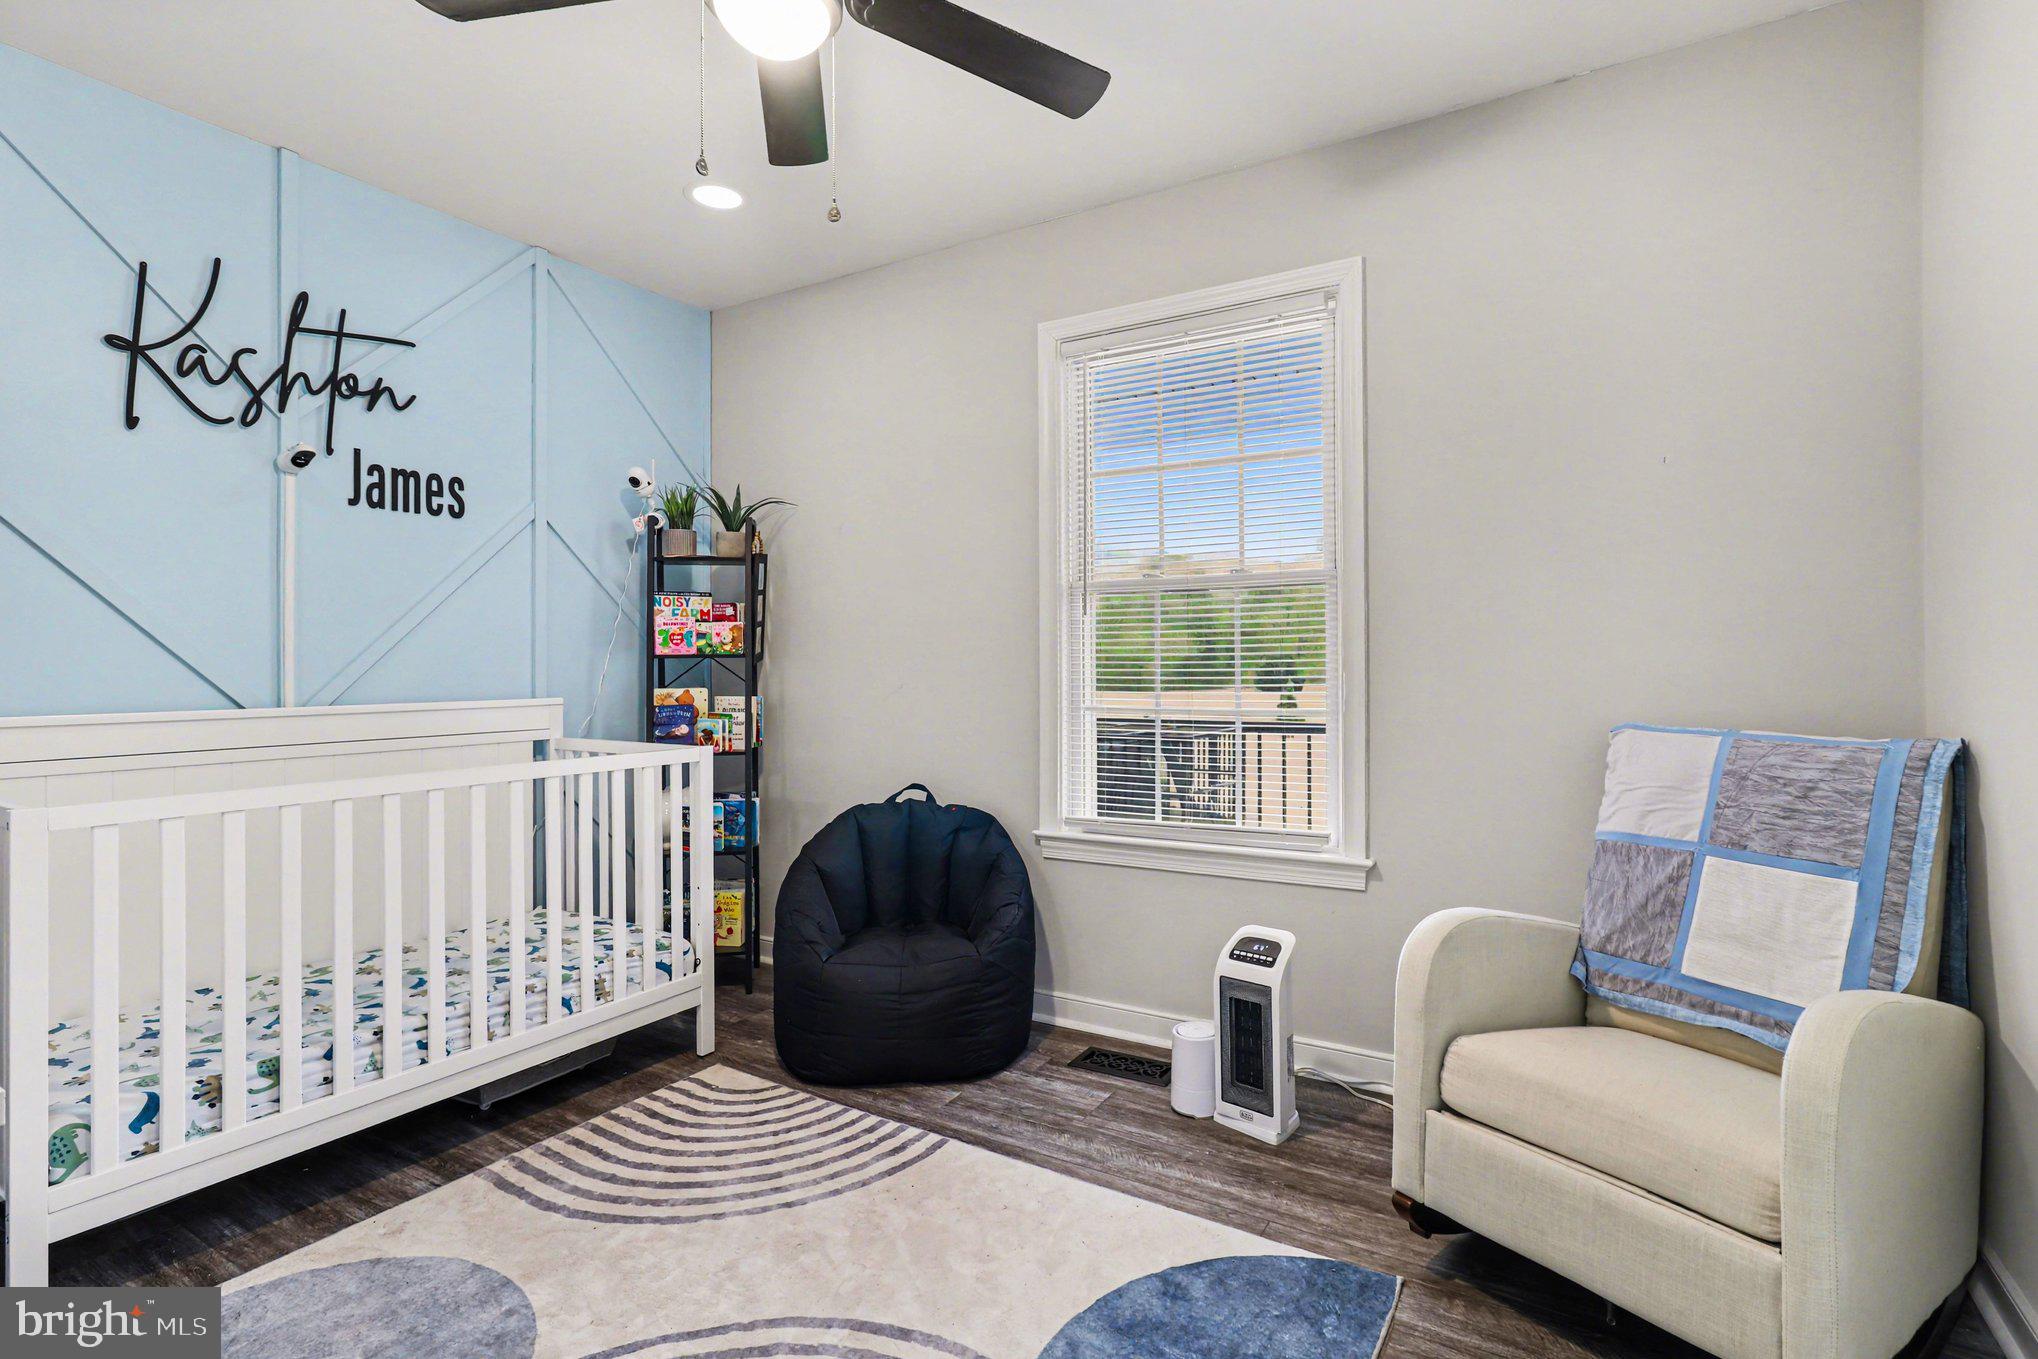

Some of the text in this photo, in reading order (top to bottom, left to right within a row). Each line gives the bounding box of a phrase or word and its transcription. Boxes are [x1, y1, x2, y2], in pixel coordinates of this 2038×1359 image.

[103, 257, 416, 456] Kashton
[347, 447, 465, 519] James
[653, 596, 691, 608] NOISY
[671, 607, 711, 621] FARM
